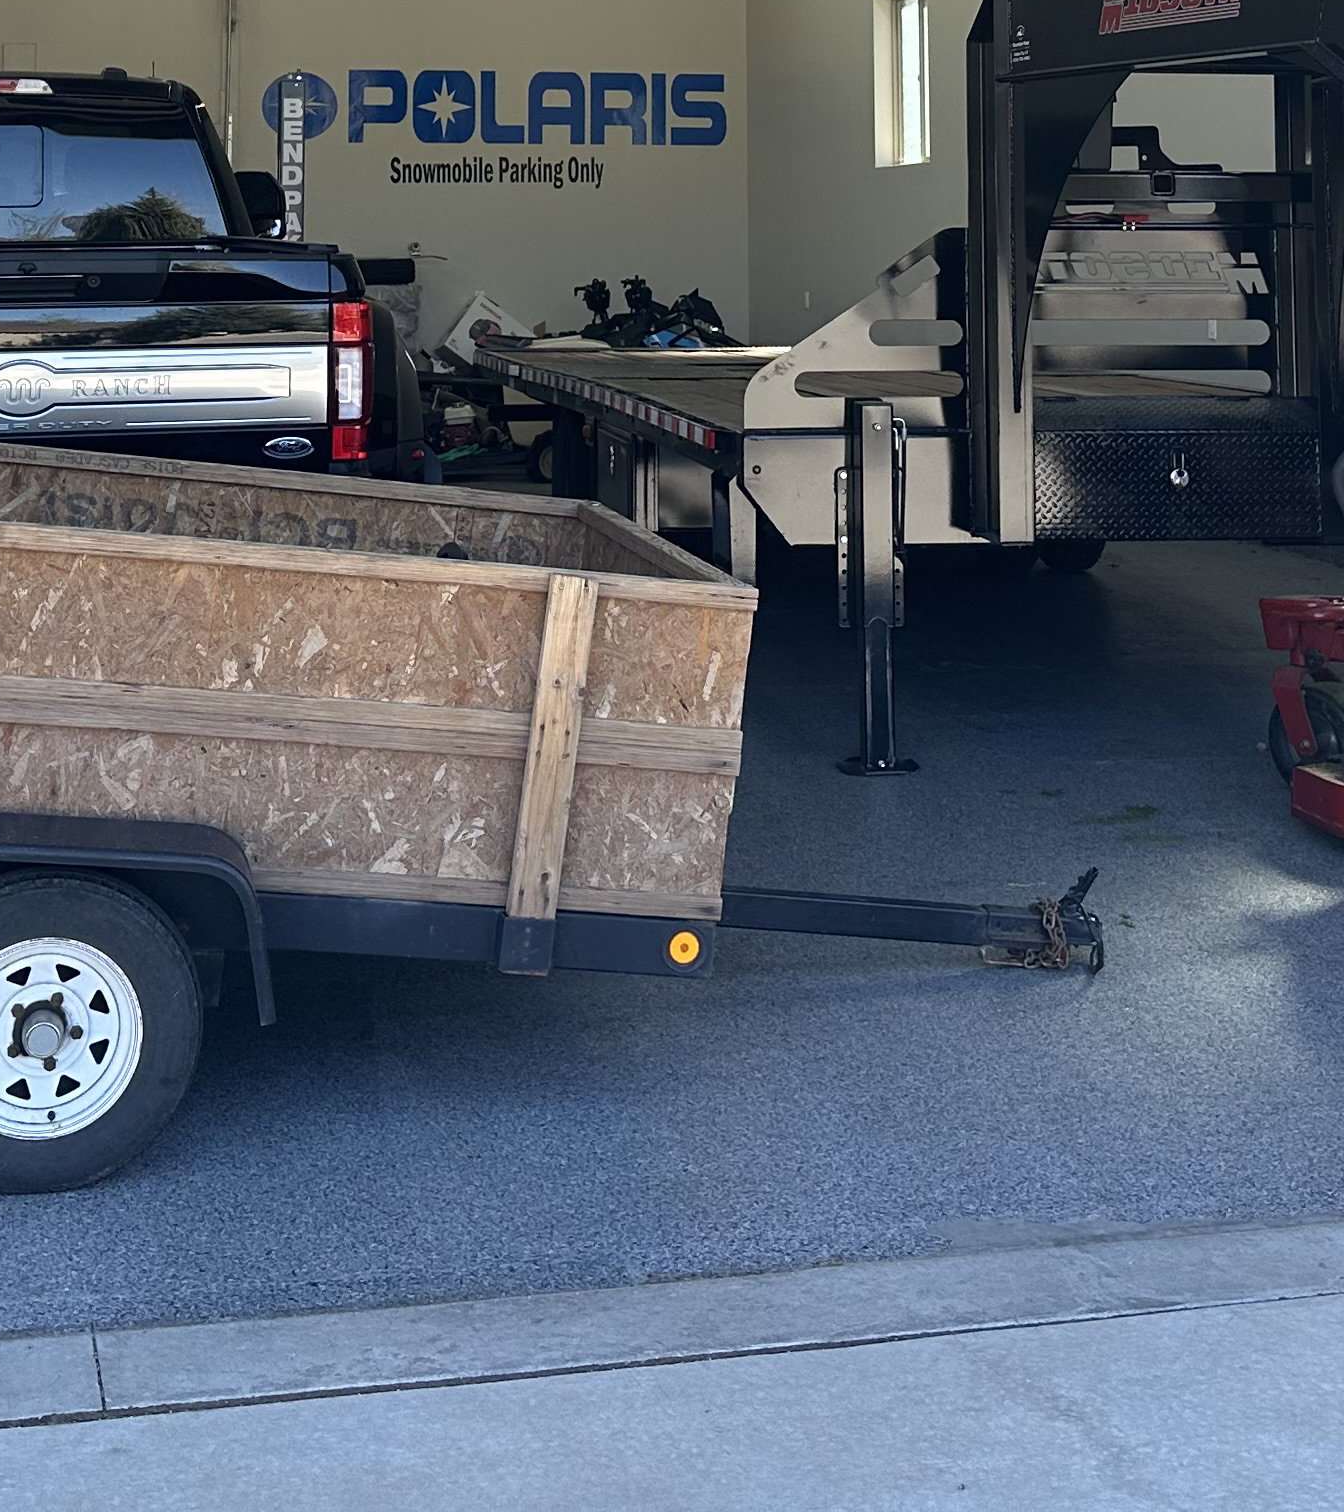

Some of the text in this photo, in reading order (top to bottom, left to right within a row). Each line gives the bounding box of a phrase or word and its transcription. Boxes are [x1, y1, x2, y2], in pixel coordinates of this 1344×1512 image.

[348, 69, 727, 146] POLARIS
[390, 156, 604, 189] Snowmobile Parking Only
[71, 374, 172, 398] RANCH
[38, 419, 112, 430] DUTY
